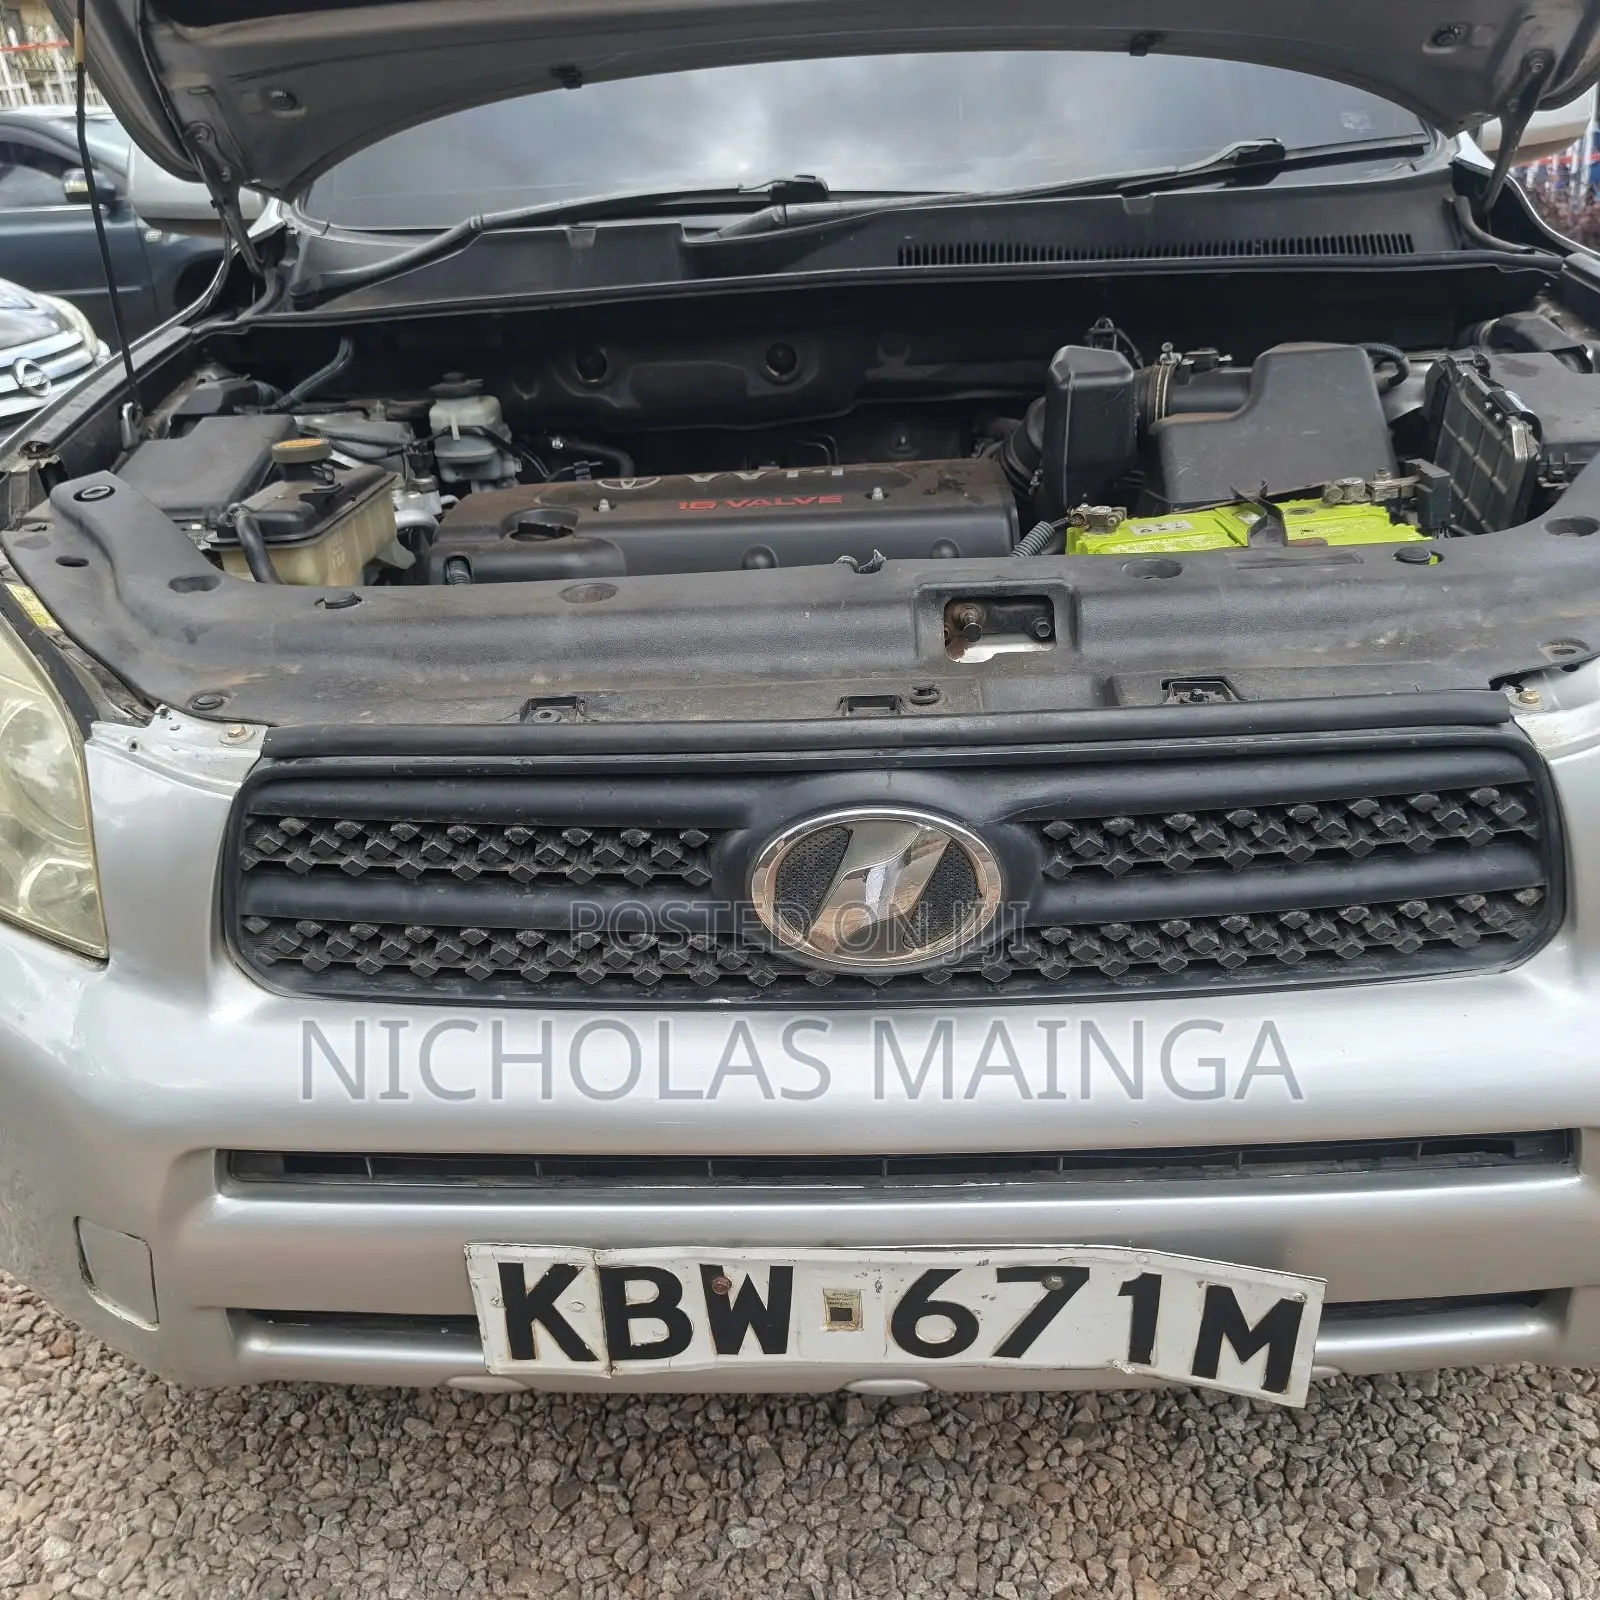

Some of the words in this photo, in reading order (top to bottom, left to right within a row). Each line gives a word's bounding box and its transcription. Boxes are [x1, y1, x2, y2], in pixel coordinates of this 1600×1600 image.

[725, 494, 843, 509] VALVE
[498, 1262, 795, 1363] KBW
[890, 1267, 1306, 1393] 671M
